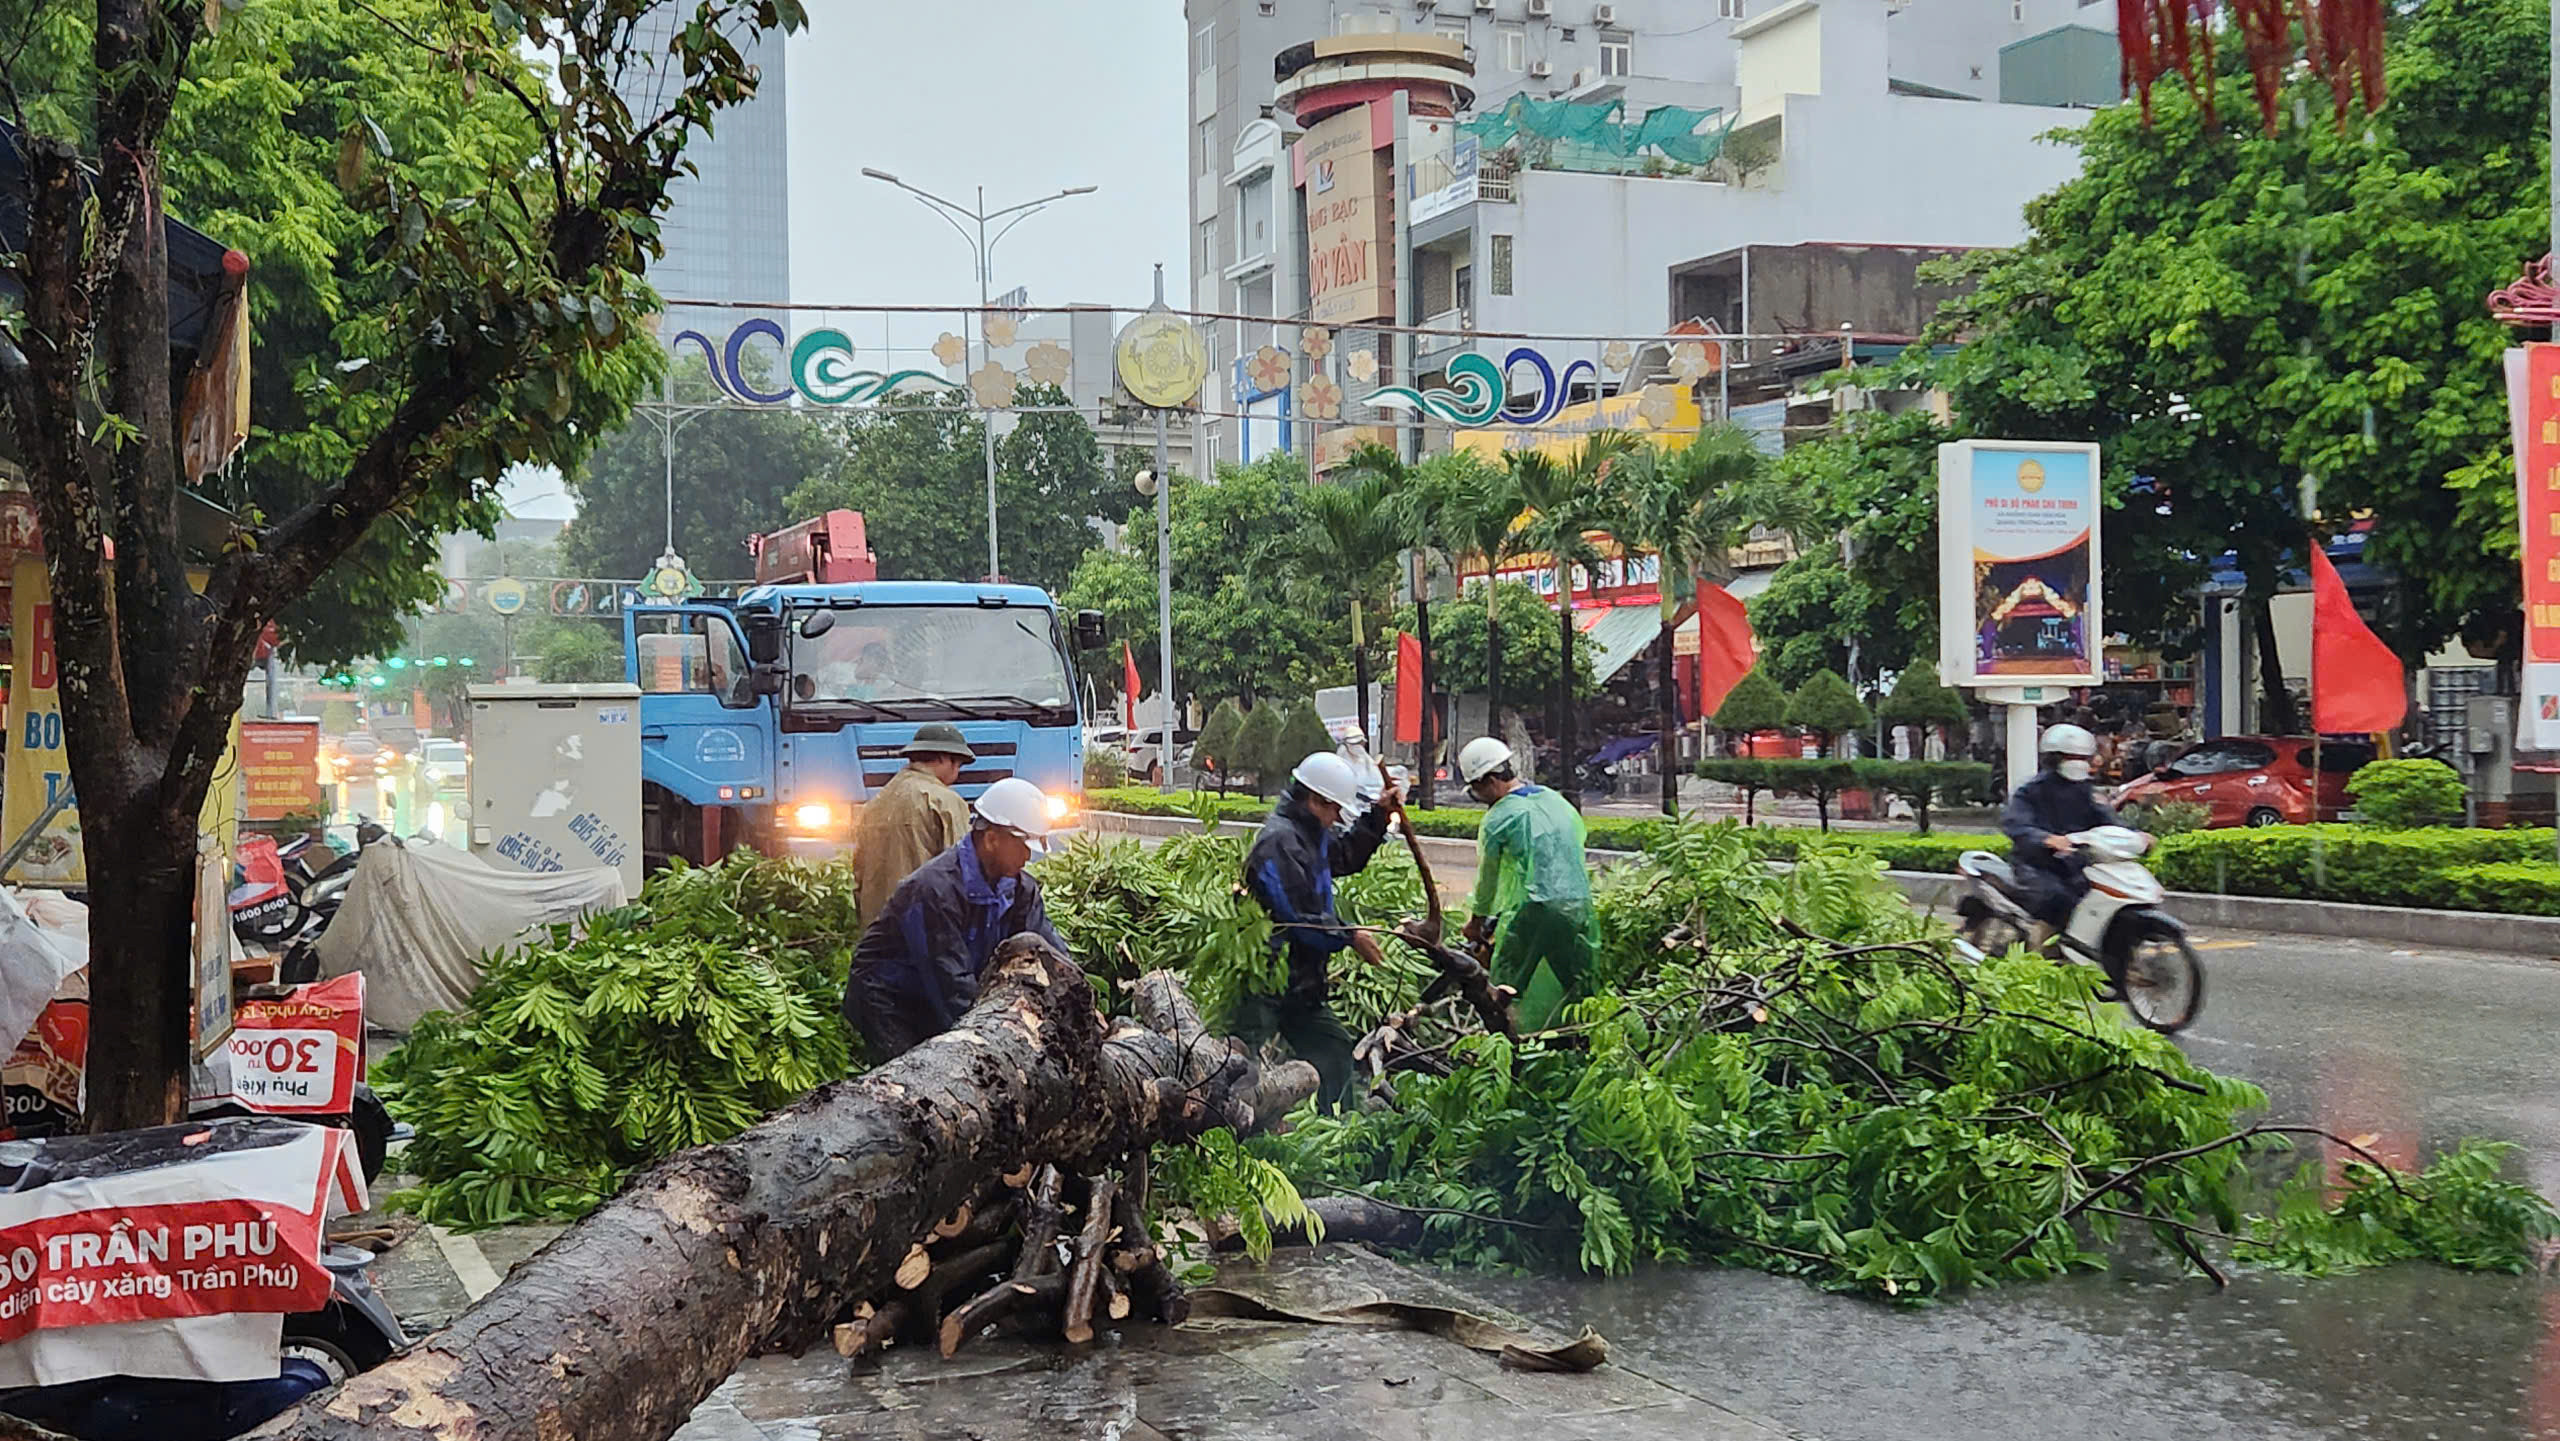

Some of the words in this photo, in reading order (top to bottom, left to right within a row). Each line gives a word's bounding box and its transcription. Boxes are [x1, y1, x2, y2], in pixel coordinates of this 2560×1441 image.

[1332, 197, 1358, 223] BẠC
[234, 906, 261, 923] 1800
[273, 1076, 308, 1096] Phụ
[46, 1217, 169, 1271] TRẦN
[183, 1211, 278, 1260] PHÚ
[0, 1287, 42, 1320] diện
[48, 1275, 97, 1304] cây
[103, 1271, 171, 1298] xăng
[177, 1264, 236, 1291] Trần
[243, 1261, 298, 1290] Phú)
